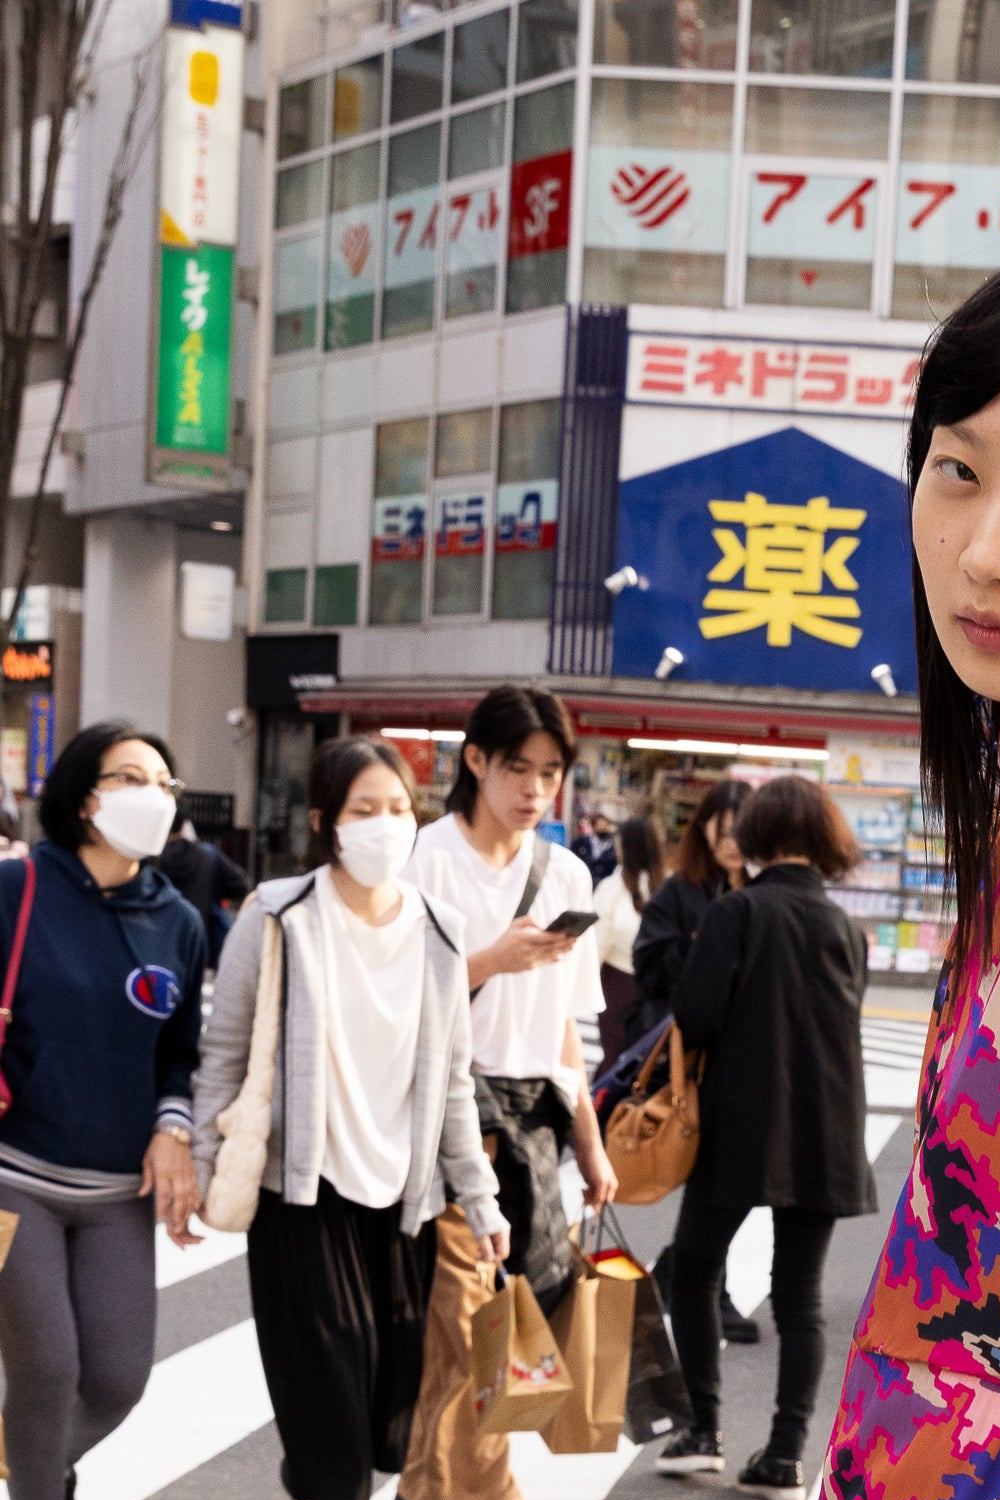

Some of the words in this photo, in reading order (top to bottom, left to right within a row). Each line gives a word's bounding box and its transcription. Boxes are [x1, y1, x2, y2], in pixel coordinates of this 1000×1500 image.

[395, 188, 499, 256] アイフル
[523, 179, 562, 237] 3F
[698, 491, 868, 649] 薬
